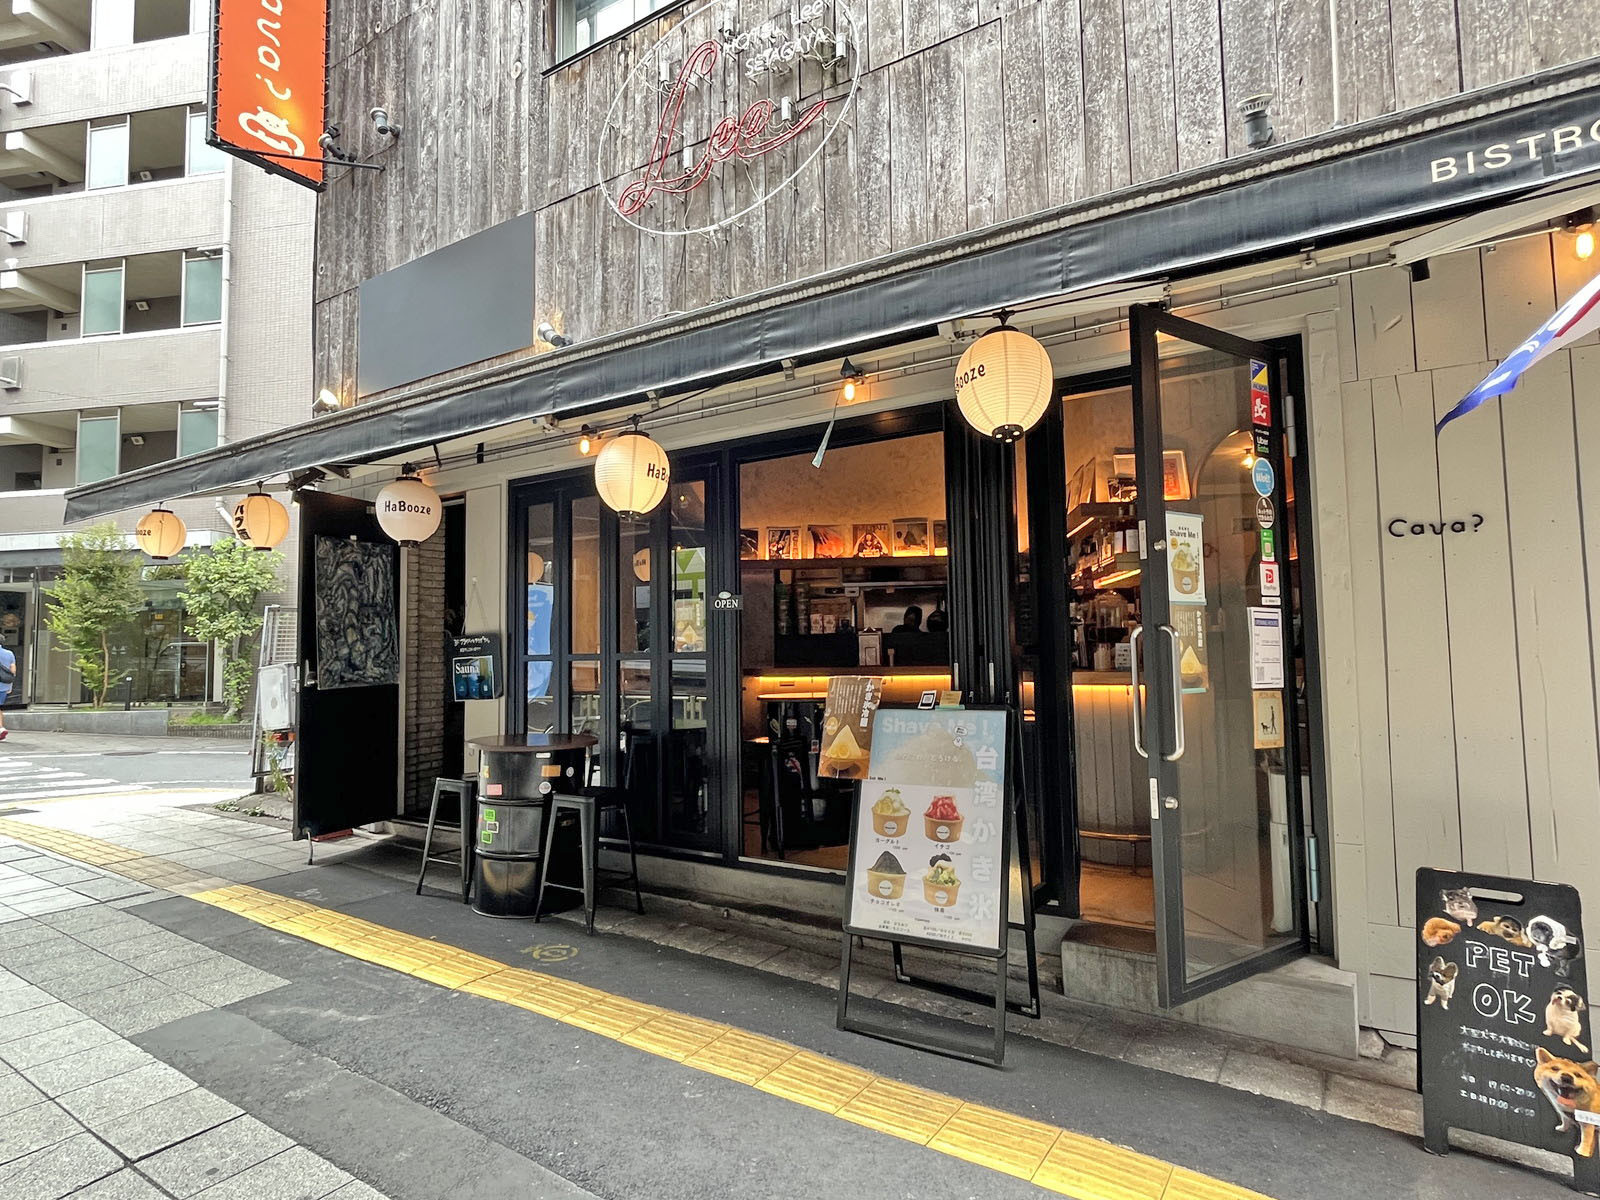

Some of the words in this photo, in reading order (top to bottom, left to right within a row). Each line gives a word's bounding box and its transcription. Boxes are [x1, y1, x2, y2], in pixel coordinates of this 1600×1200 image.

[384, 500, 431, 515] HaBooze
[1388, 513, 1484, 537] Cava?
[714, 599, 739, 609] OPEN
[455, 662, 480, 674] Sauna
[968, 744, 999, 922] 台湾かき氷
[1465, 940, 1536, 977] PET
[1473, 983, 1537, 1025] OK
